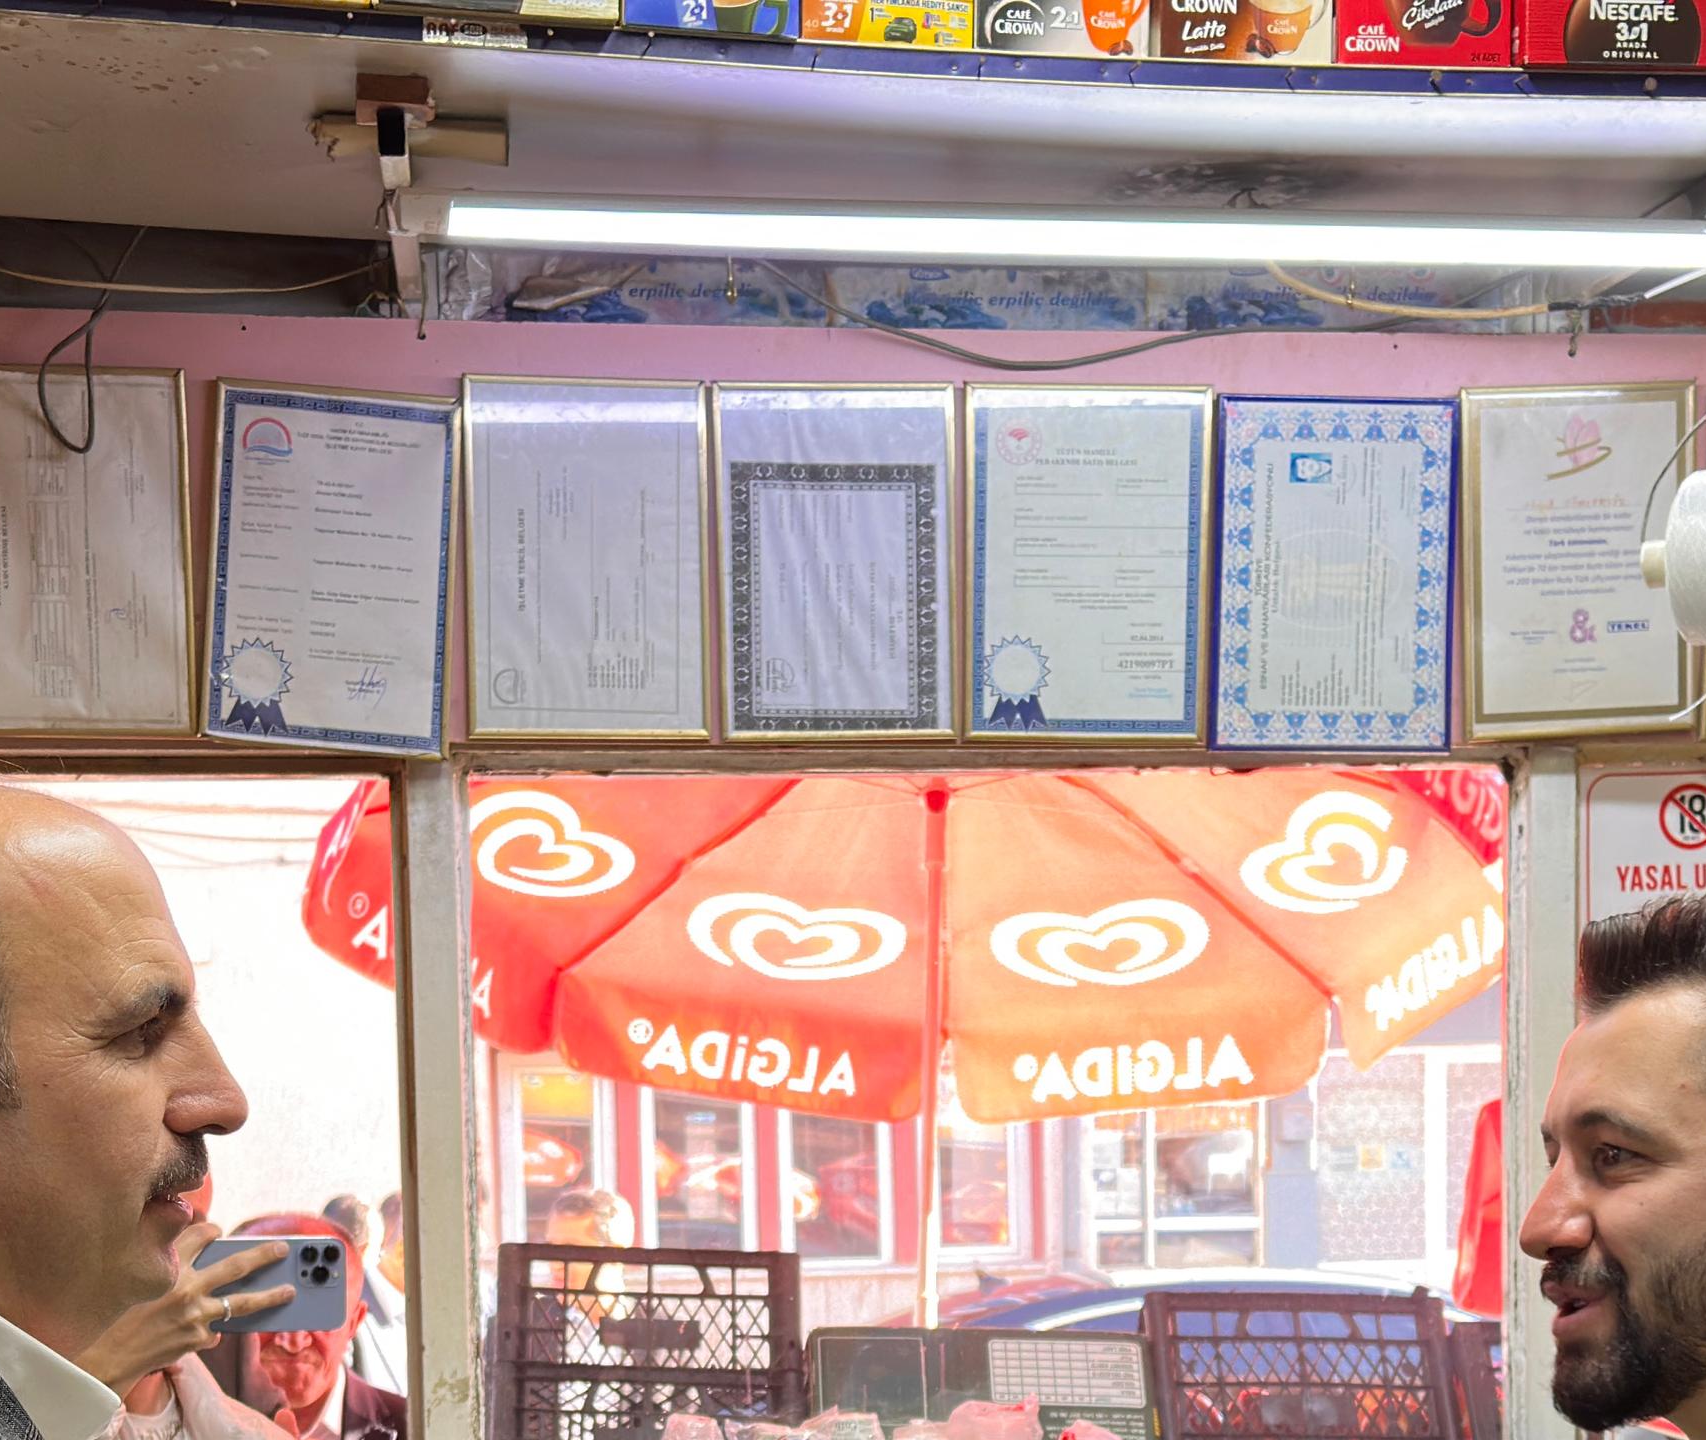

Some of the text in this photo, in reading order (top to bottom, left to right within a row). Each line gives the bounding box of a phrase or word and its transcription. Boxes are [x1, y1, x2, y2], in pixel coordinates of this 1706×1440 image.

[995, 19, 1045, 37] CROWN
[1182, 20, 1227, 42] Latte
[1345, 36, 1400, 54] CROWN
[1602, 50, 1660, 60] ORIGINAL
[1616, 863, 1688, 892] YASAL
